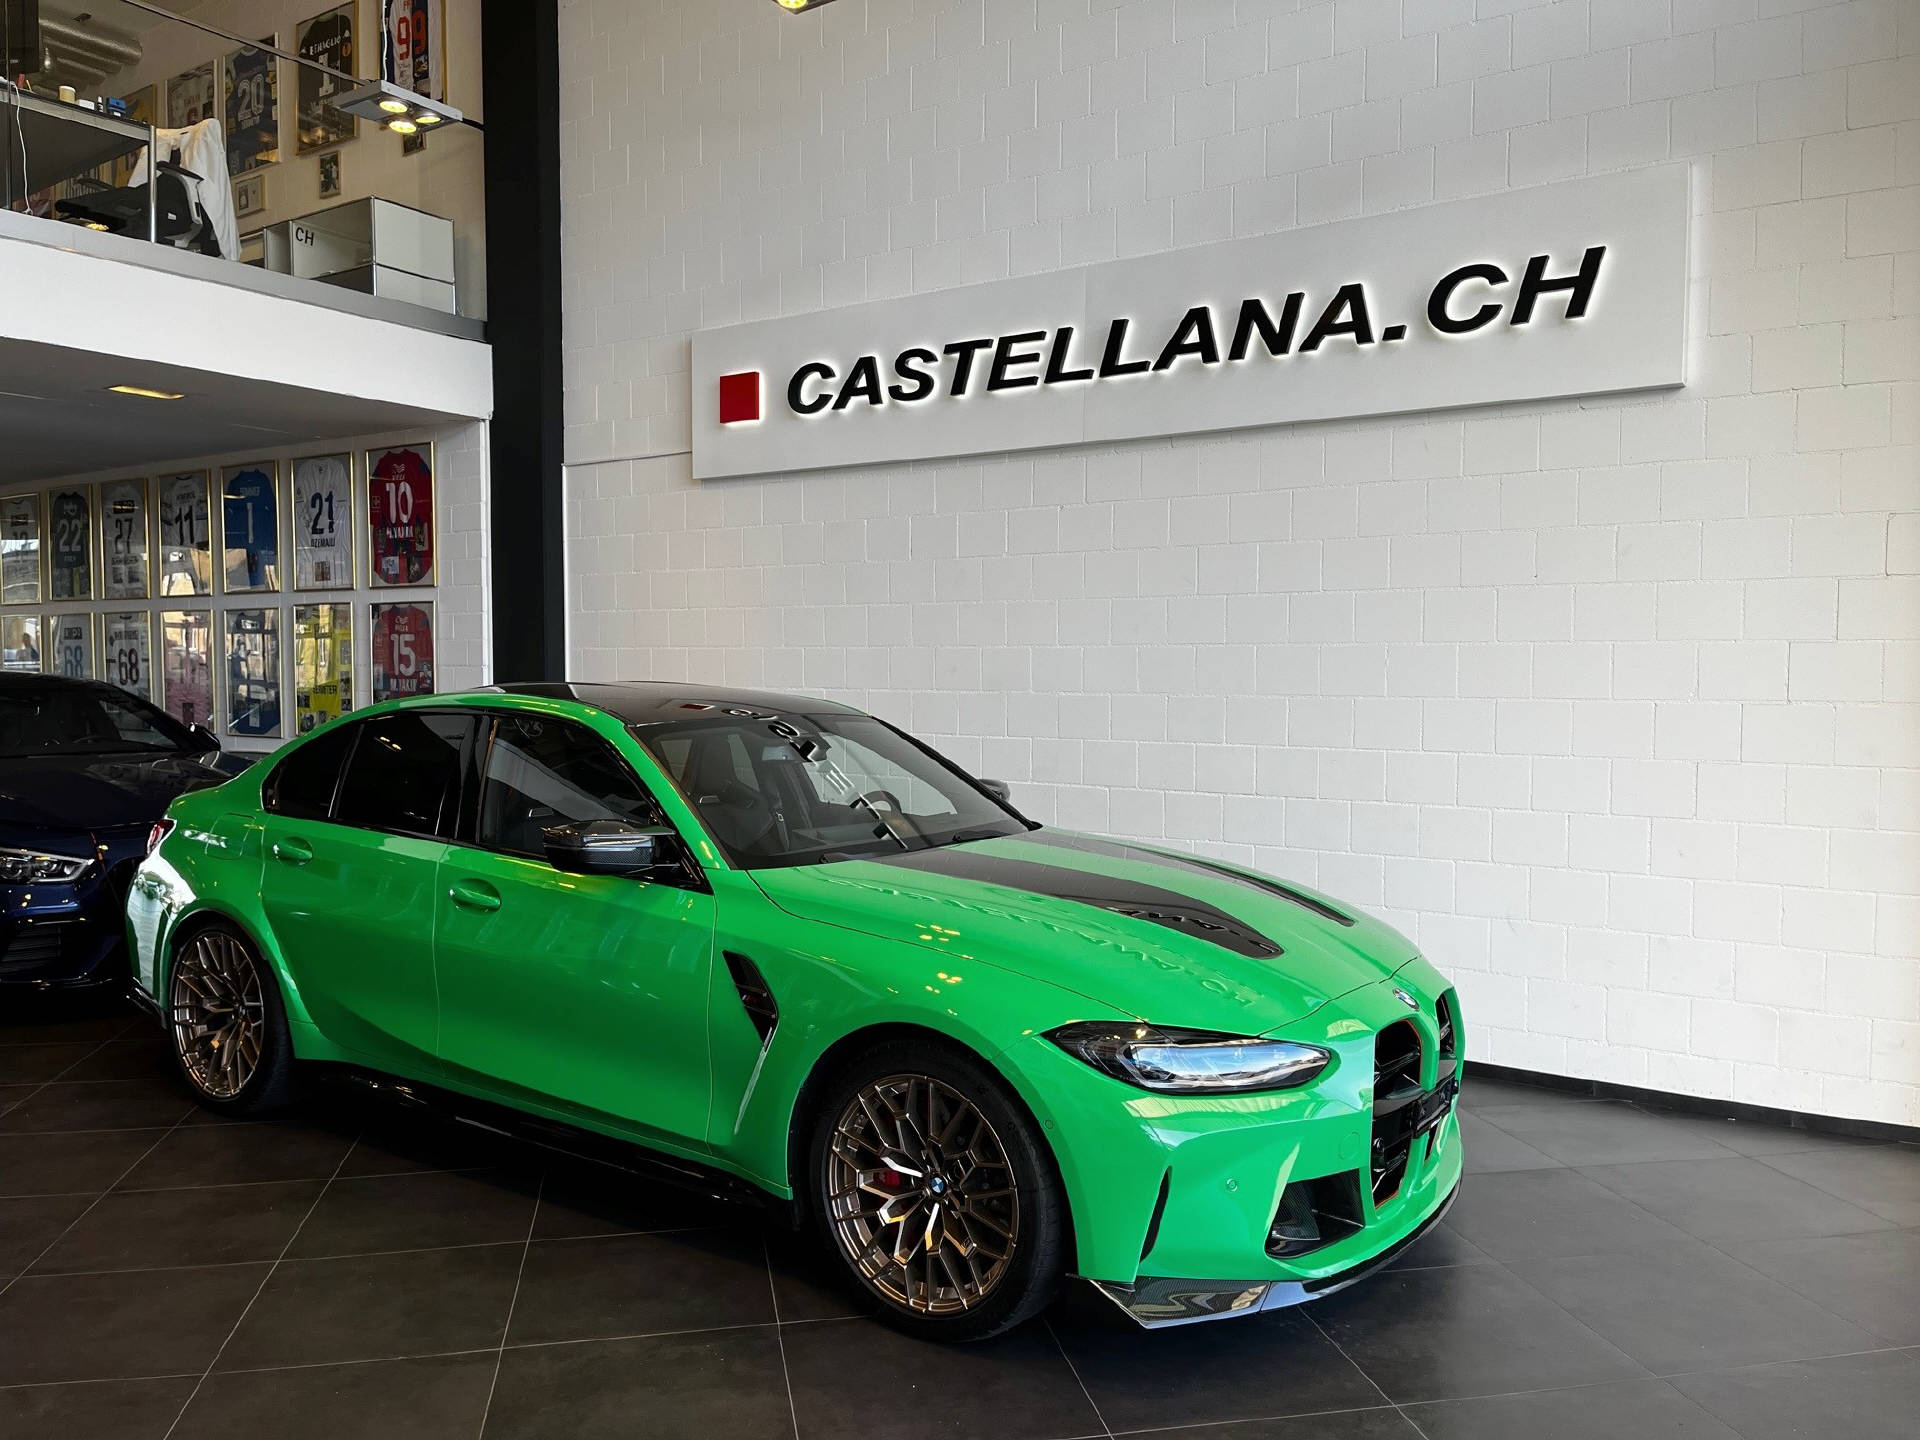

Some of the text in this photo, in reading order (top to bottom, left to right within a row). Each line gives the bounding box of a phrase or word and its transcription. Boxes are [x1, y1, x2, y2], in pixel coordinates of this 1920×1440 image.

[397, 10, 427, 60] 99
[238, 73, 265, 121] 20
[295, 226, 315, 247] CH
[788, 246, 1605, 416] CASTELLANA.CH
[311, 491, 335, 534] 21
[385, 481, 413, 524] 10
[59, 519, 82, 553] 22
[114, 517, 134, 554] 27
[175, 505, 195, 546] 11
[118, 648, 140, 686] 68
[390, 633, 416, 677] 15
